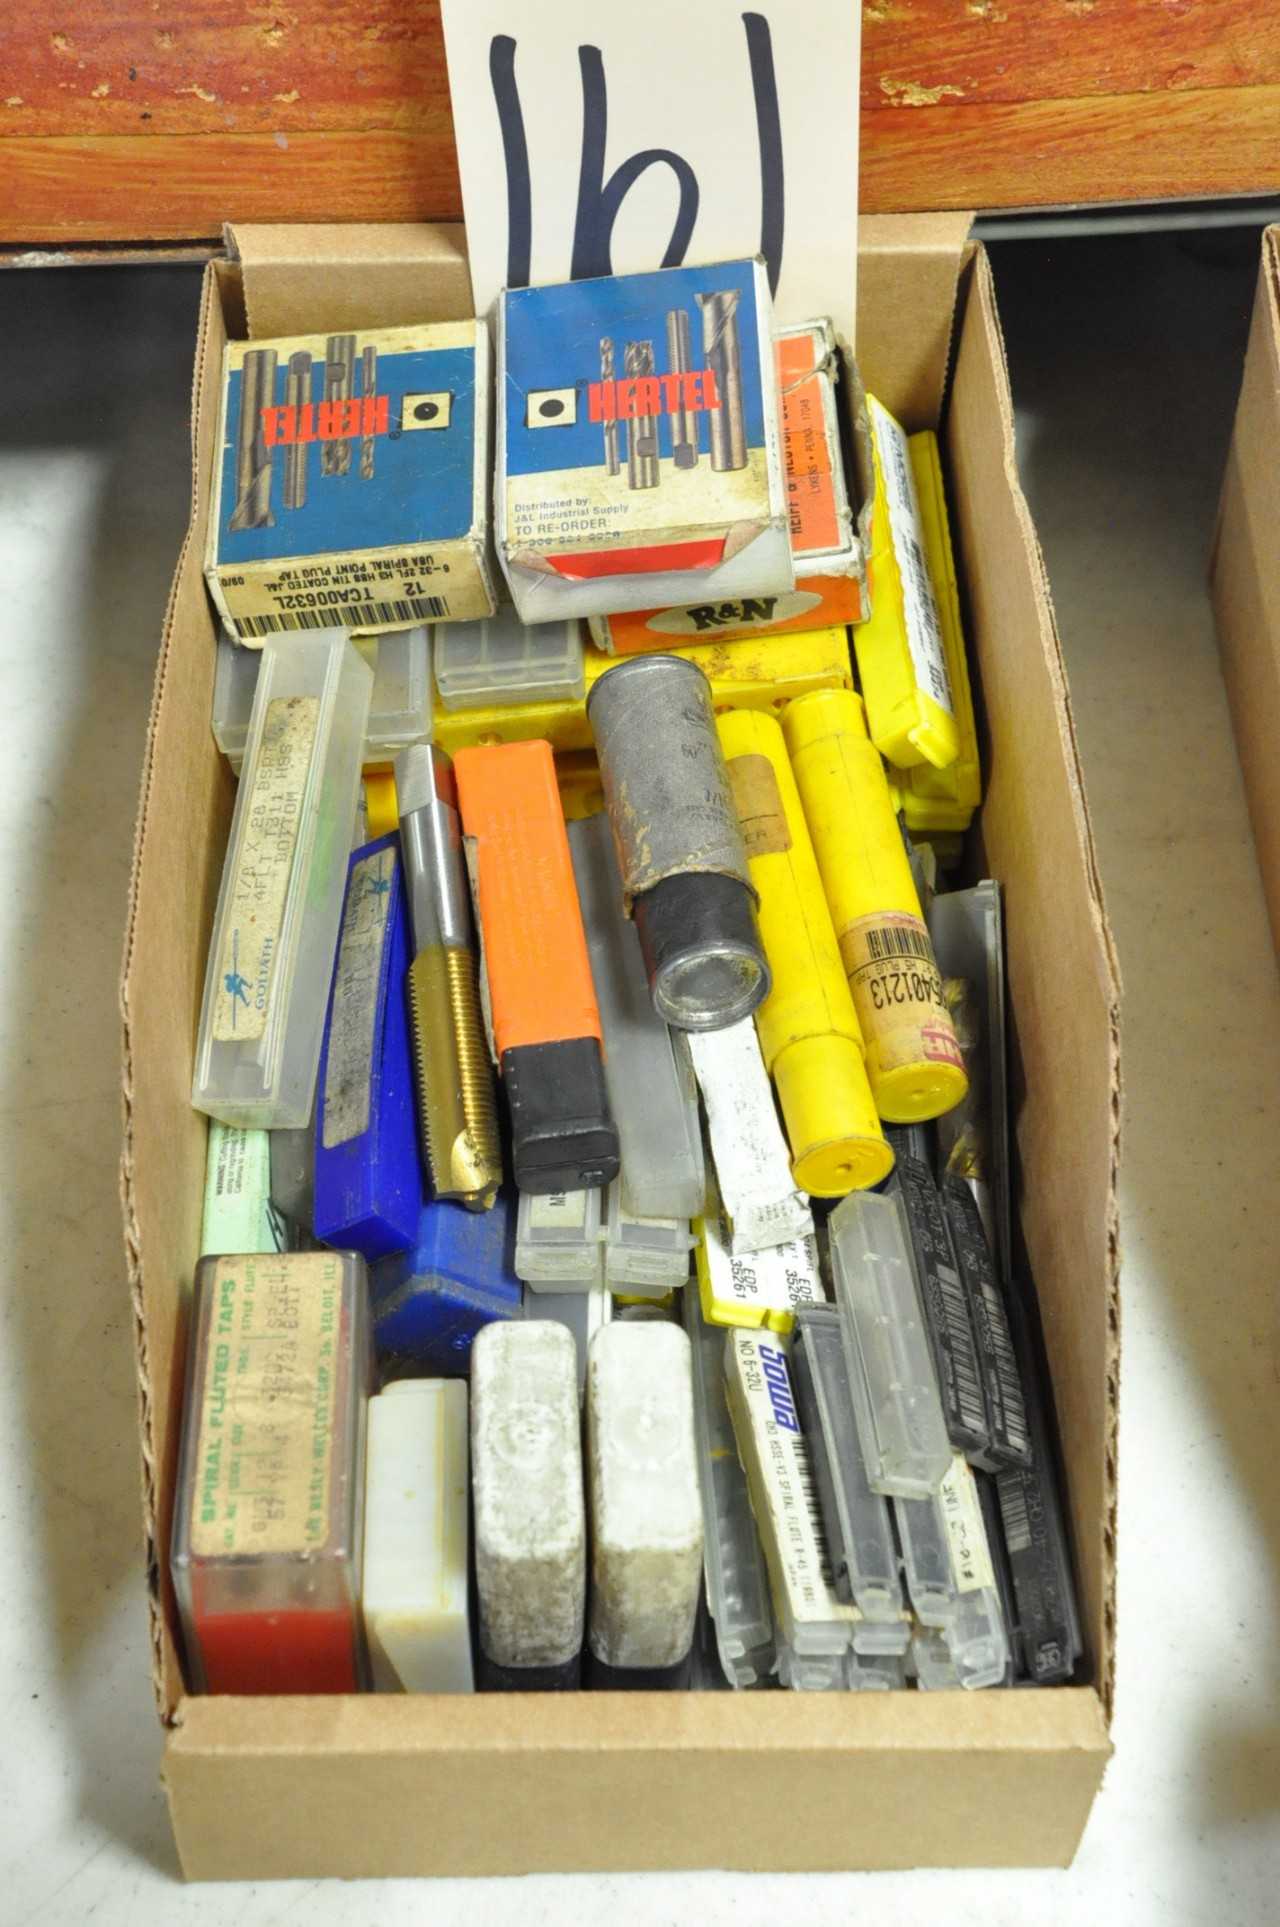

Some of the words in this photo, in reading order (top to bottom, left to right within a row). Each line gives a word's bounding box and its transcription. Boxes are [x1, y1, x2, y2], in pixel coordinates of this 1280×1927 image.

[589, 369, 722, 422] HERTEL
[261, 396, 389, 446] HERTEL
[514, 499, 572, 513] Distributed
[514, 514, 535, 523] J&L
[539, 509, 589, 521] Industrial
[593, 504, 629, 515] Supply
[516, 525, 532, 535] TO
[302, 566, 331, 577] PLUG
[336, 563, 366, 573] POINT
[370, 559, 407, 570] SPIRAL
[397, 568, 416, 579] 2FL
[278, 571, 298, 581] TAP
[288, 577, 328, 589] COATED
[332, 575, 350, 585] TIN
[273, 587, 373, 609] TCA00632L
[403, 582, 426, 597] 12
[687, 597, 778, 632] R&N
[273, 791, 298, 862] BOTTOM
[255, 937, 274, 1010] GOLIATH
[728, 1257, 749, 1300] 35261
[742, 1265, 758, 1295] EDP
[218, 1280, 236, 1334] TAPS
[738, 1338, 754, 1356] NO
[210, 1344, 228, 1427] FLUTED
[200, 1439, 222, 1523] SPIRAL
